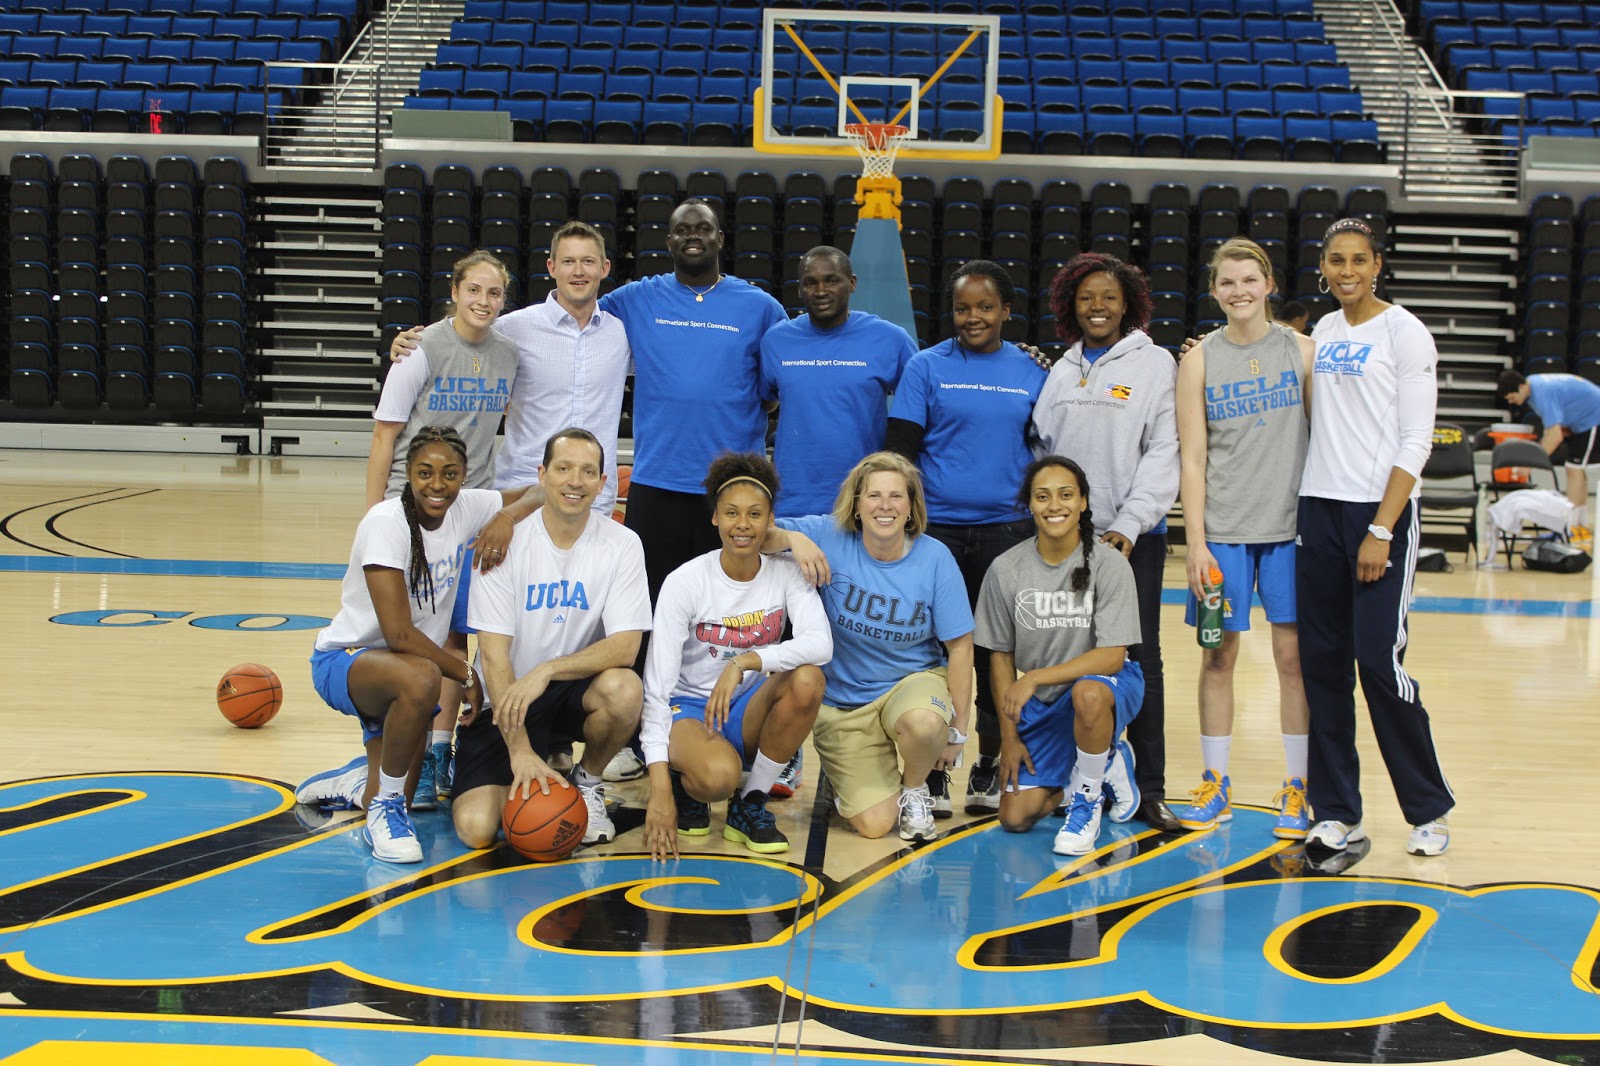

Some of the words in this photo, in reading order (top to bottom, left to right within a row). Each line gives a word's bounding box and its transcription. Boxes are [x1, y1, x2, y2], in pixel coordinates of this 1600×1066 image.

[655, 318, 689, 327] International
[706, 322, 740, 333] Connection
[1317, 343, 1373, 364] UCLA
[1250, 359, 1260, 375] B
[434, 377, 509, 395] UCLA
[940, 382, 978, 390] International
[997, 386, 1030, 396] Connection
[1206, 370, 1299, 403] UCLA
[428, 394, 508, 412] BASKETBALL
[1092, 399, 1126, 410] Connection
[1207, 388, 1302, 421] BASKETBALL
[525, 580, 590, 611] UCLA
[843, 583, 927, 627] UCLA
[1034, 590, 1095, 616] UCLA
[1203, 592, 1222, 611] G
[722, 609, 766, 628] HOLIDAY
[837, 613, 926, 643] BASKETBALL
[1035, 617, 1093, 629] BASKETBL
[695, 609, 785, 649] CLASSIC
[1202, 628, 1222, 643] 02
